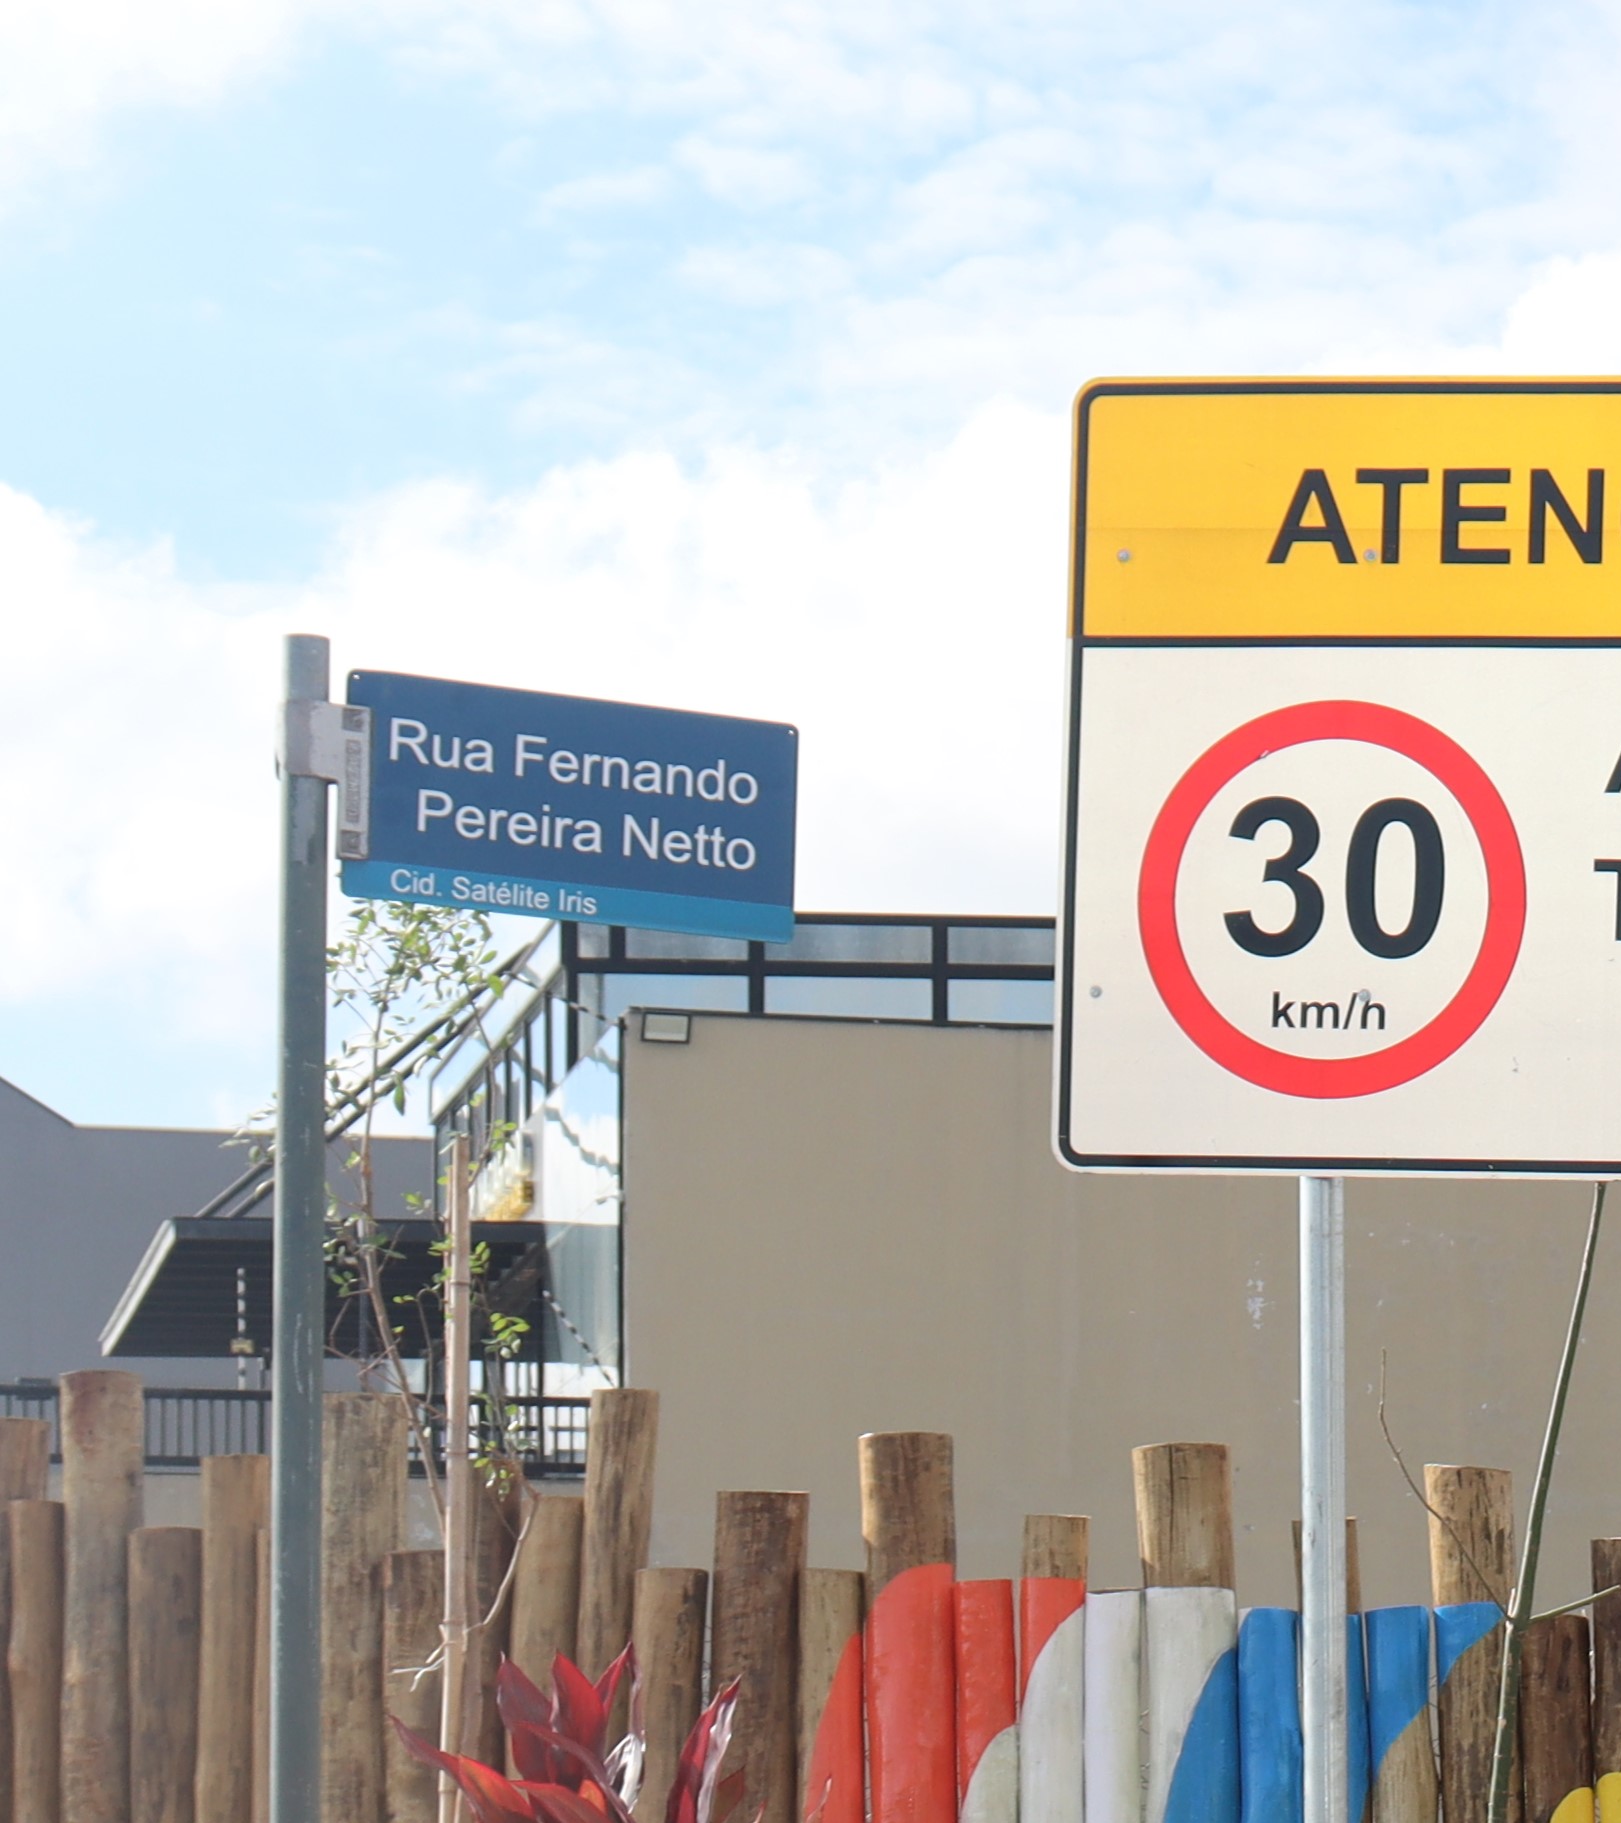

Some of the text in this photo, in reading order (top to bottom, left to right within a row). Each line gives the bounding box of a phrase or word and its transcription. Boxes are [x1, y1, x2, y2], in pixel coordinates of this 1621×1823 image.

[388, 716, 759, 805] Rua Fernando
[416, 788, 757, 871] Pereira Netto
[391, 868, 597, 916] Cid. Satélite Iris
[1224, 797, 1445, 960] 30
[1272, 992, 1387, 1030] km/h
